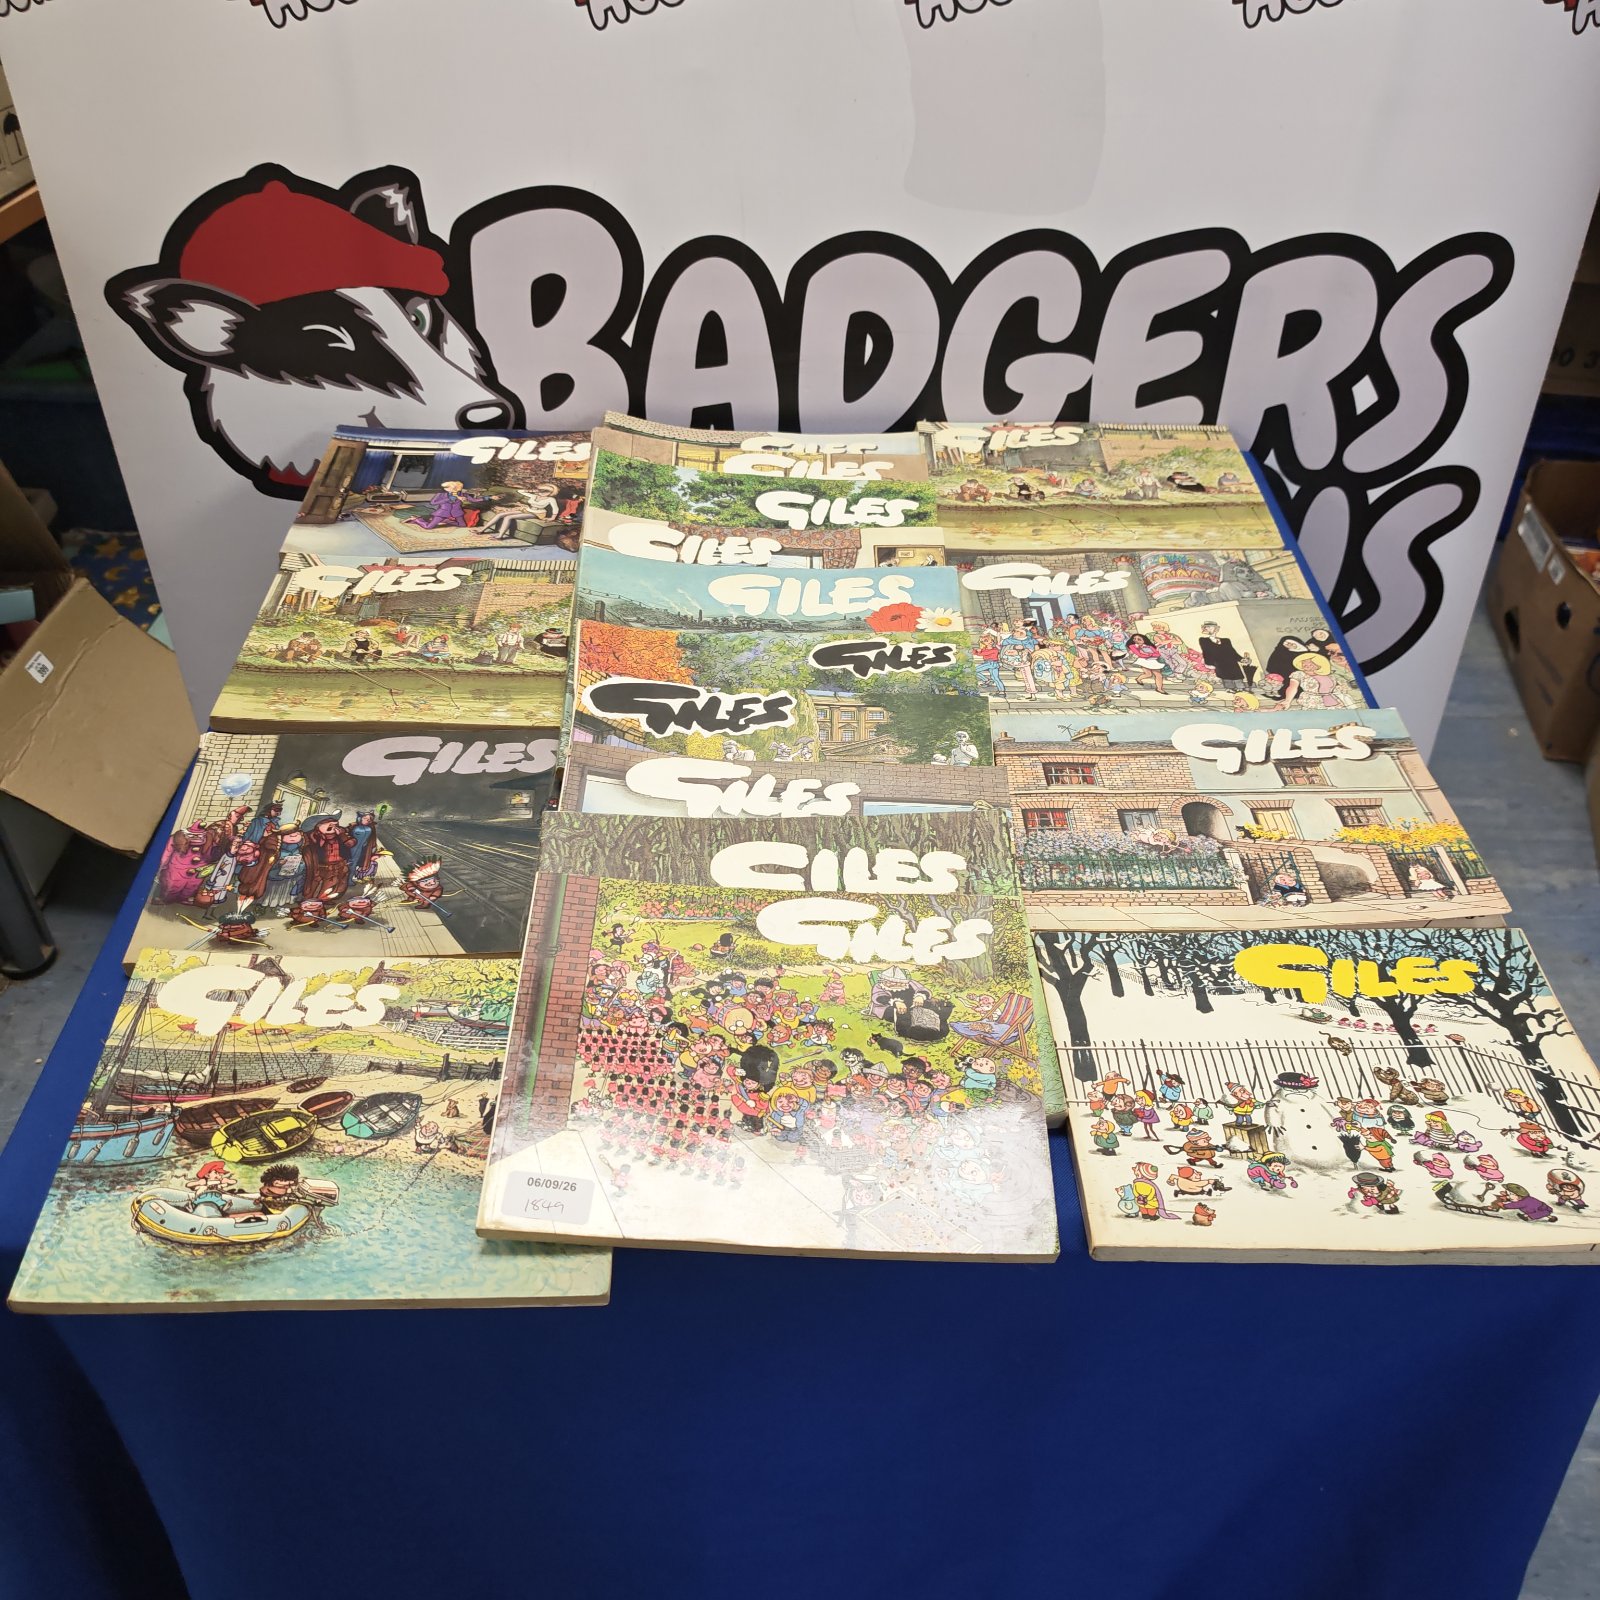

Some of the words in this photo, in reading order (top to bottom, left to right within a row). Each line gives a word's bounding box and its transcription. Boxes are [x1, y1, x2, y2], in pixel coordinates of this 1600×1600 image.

[450, 185, 1513, 484] BADGERS
[451, 436, 592, 464] GILES
[936, 426, 1084, 453] GILES
[755, 490, 920, 530] GILES
[299, 565, 474, 598] GILES
[708, 573, 915, 617] GILES
[961, 563, 1132, 599] GILES
[811, 641, 956, 676] GILES
[590, 682, 794, 734] GILES
[342, 736, 559, 785] GILES
[1171, 723, 1377, 774] GILES
[625, 758, 862, 818] GILES
[756, 897, 994, 964] GILES
[1234, 943, 1480, 1004] GILES
[157, 965, 401, 1037] GILES
[524, 1198, 564, 1214] 1849
[527, 1177, 577, 1192] 06/09/26
